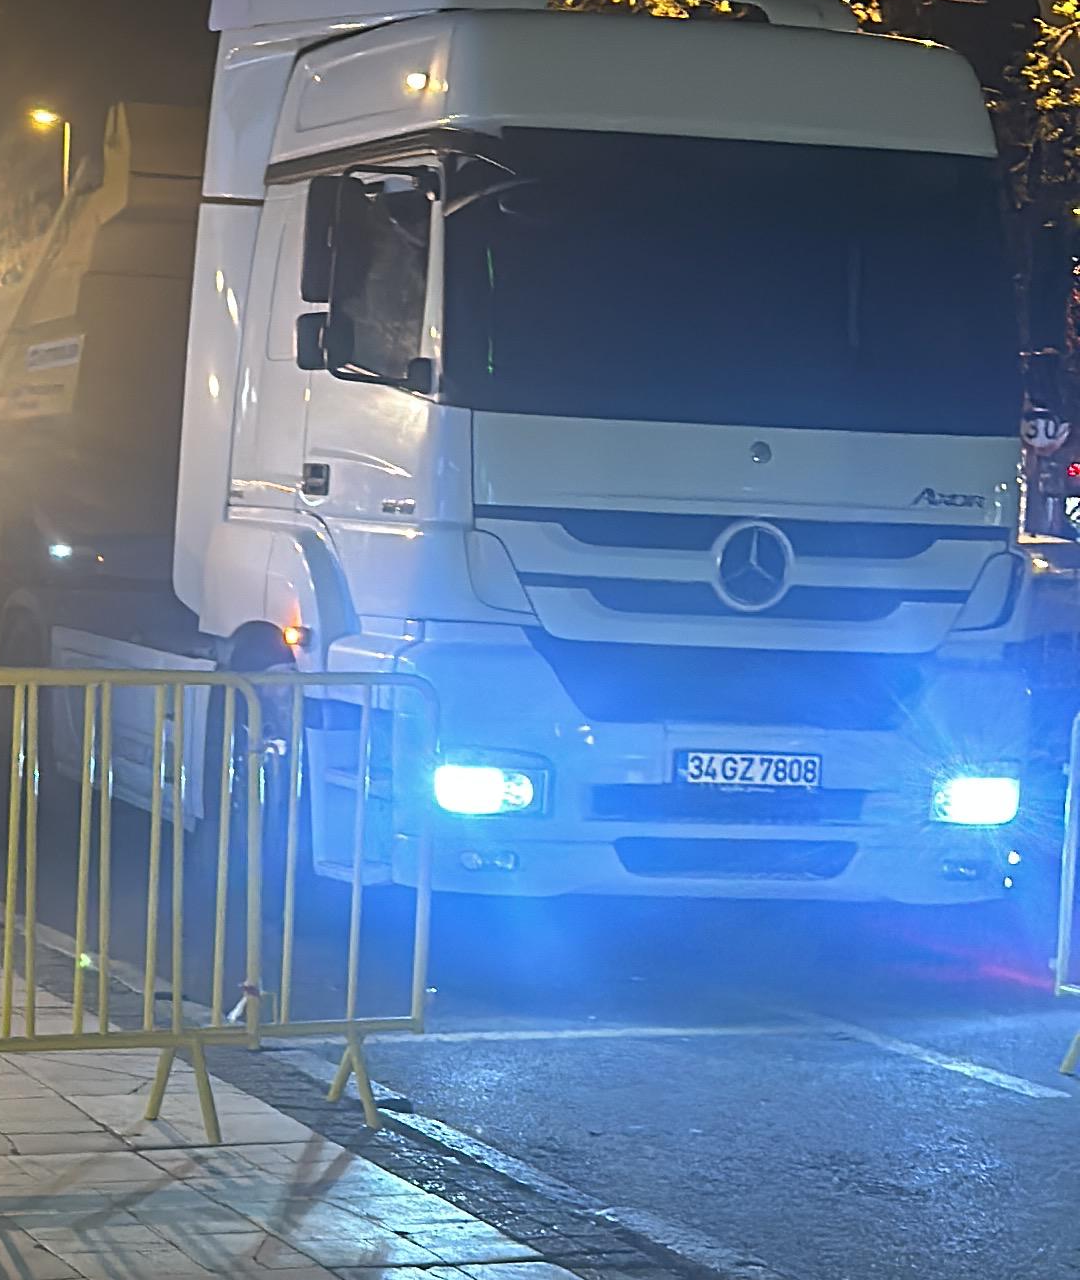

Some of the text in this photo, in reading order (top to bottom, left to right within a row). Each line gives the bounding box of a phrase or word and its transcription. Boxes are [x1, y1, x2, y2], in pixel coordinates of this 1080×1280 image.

[689, 755, 817, 784] 34 GZ 7808
